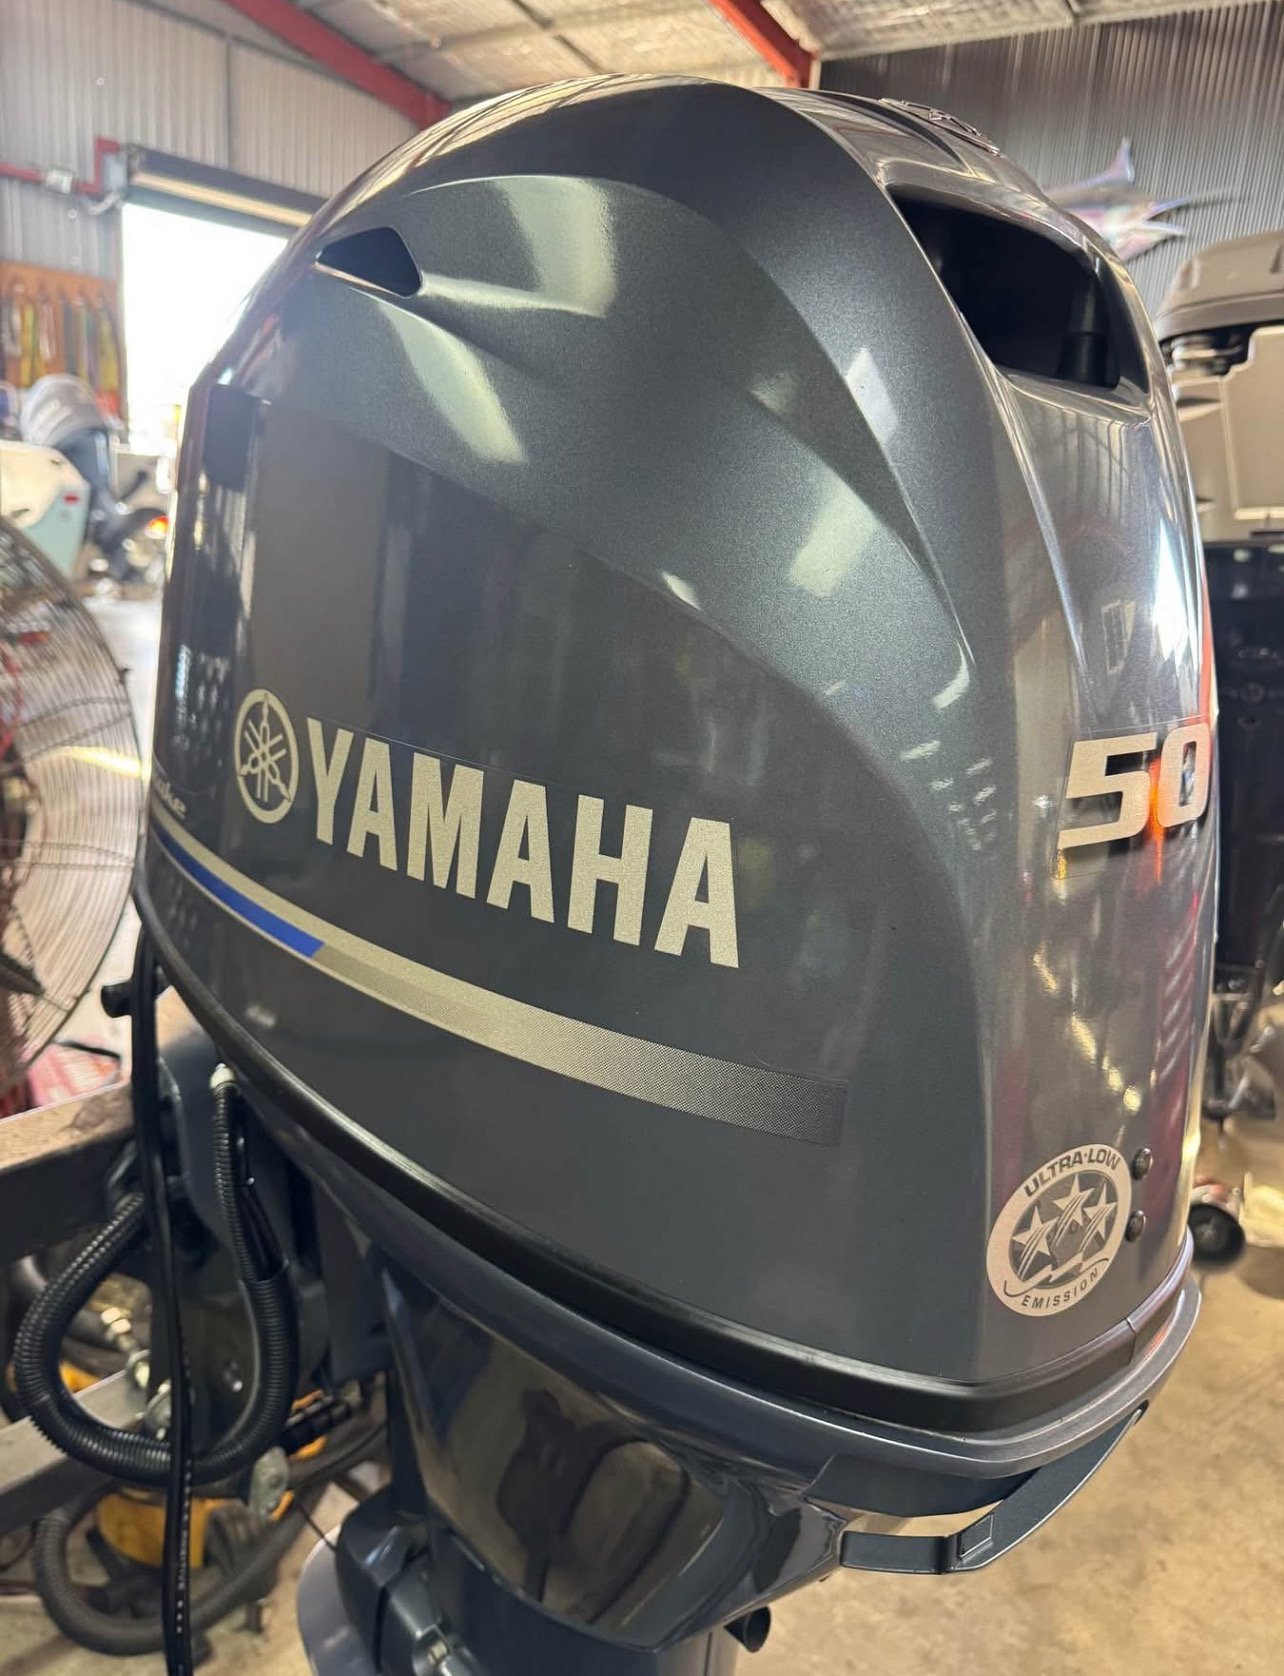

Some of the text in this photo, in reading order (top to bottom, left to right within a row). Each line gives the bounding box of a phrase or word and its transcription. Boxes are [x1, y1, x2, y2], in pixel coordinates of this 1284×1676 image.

[307, 716, 739, 968] YAMAHA
[1057, 722, 1212, 849] 50
[1021, 1267, 1099, 1309] EMISSION
